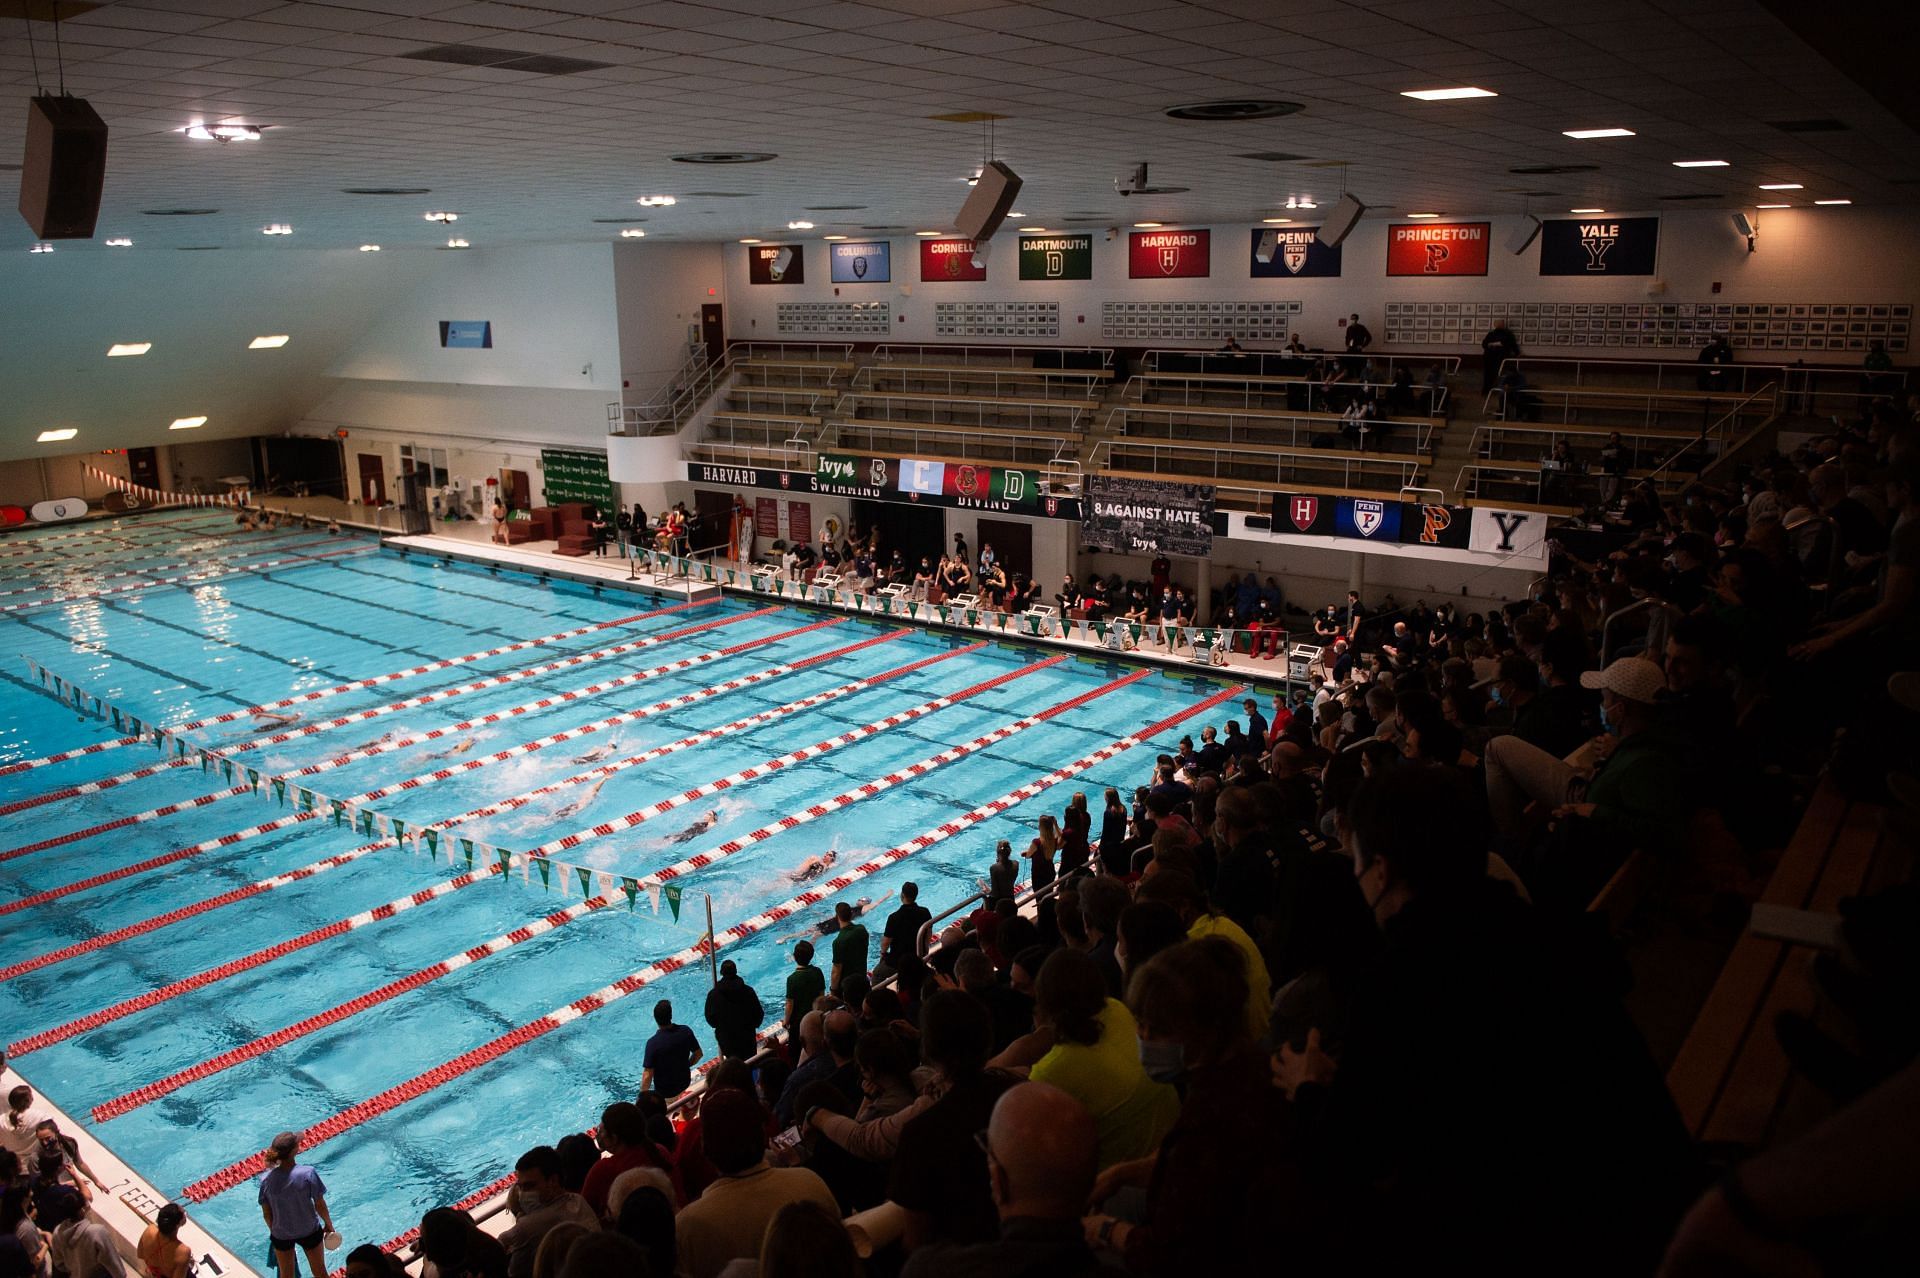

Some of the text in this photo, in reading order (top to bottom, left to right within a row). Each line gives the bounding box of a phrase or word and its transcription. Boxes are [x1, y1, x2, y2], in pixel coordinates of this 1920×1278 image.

[1277, 232, 1315, 245] PENN
[1397, 229, 1481, 241] PRINCETON
[1579, 225, 1619, 238] YALE
[931, 243, 975, 254] CORNELL
[1022, 239, 1088, 251] DARTMOUTH
[1141, 235, 1198, 248] HARVARD
[837, 246, 882, 256] COLUMBIA
[1163, 250, 1174, 267] H
[1424, 243, 1449, 272] P
[1582, 239, 1614, 270] Y
[1046, 251, 1063, 277] D
[703, 466, 757, 485] HARVARD
[818, 456, 843, 479] Ivy
[913, 460, 929, 491] C
[782, 474, 788, 484] H
[1003, 469, 1025, 501] D
[1047, 500, 1056, 512] H
[1094, 502, 1102, 515] 8
[1105, 503, 1162, 520] AGAINST
[1165, 509, 1200, 524] HATE
[1296, 500, 1312, 521] H
[1357, 503, 1380, 512] PENN
[1363, 513, 1375, 529] P
[1420, 505, 1451, 543] P
[1490, 511, 1529, 551] Y
[1132, 537, 1149, 551] Ivy
[199, 1253, 223, 1276] 1
